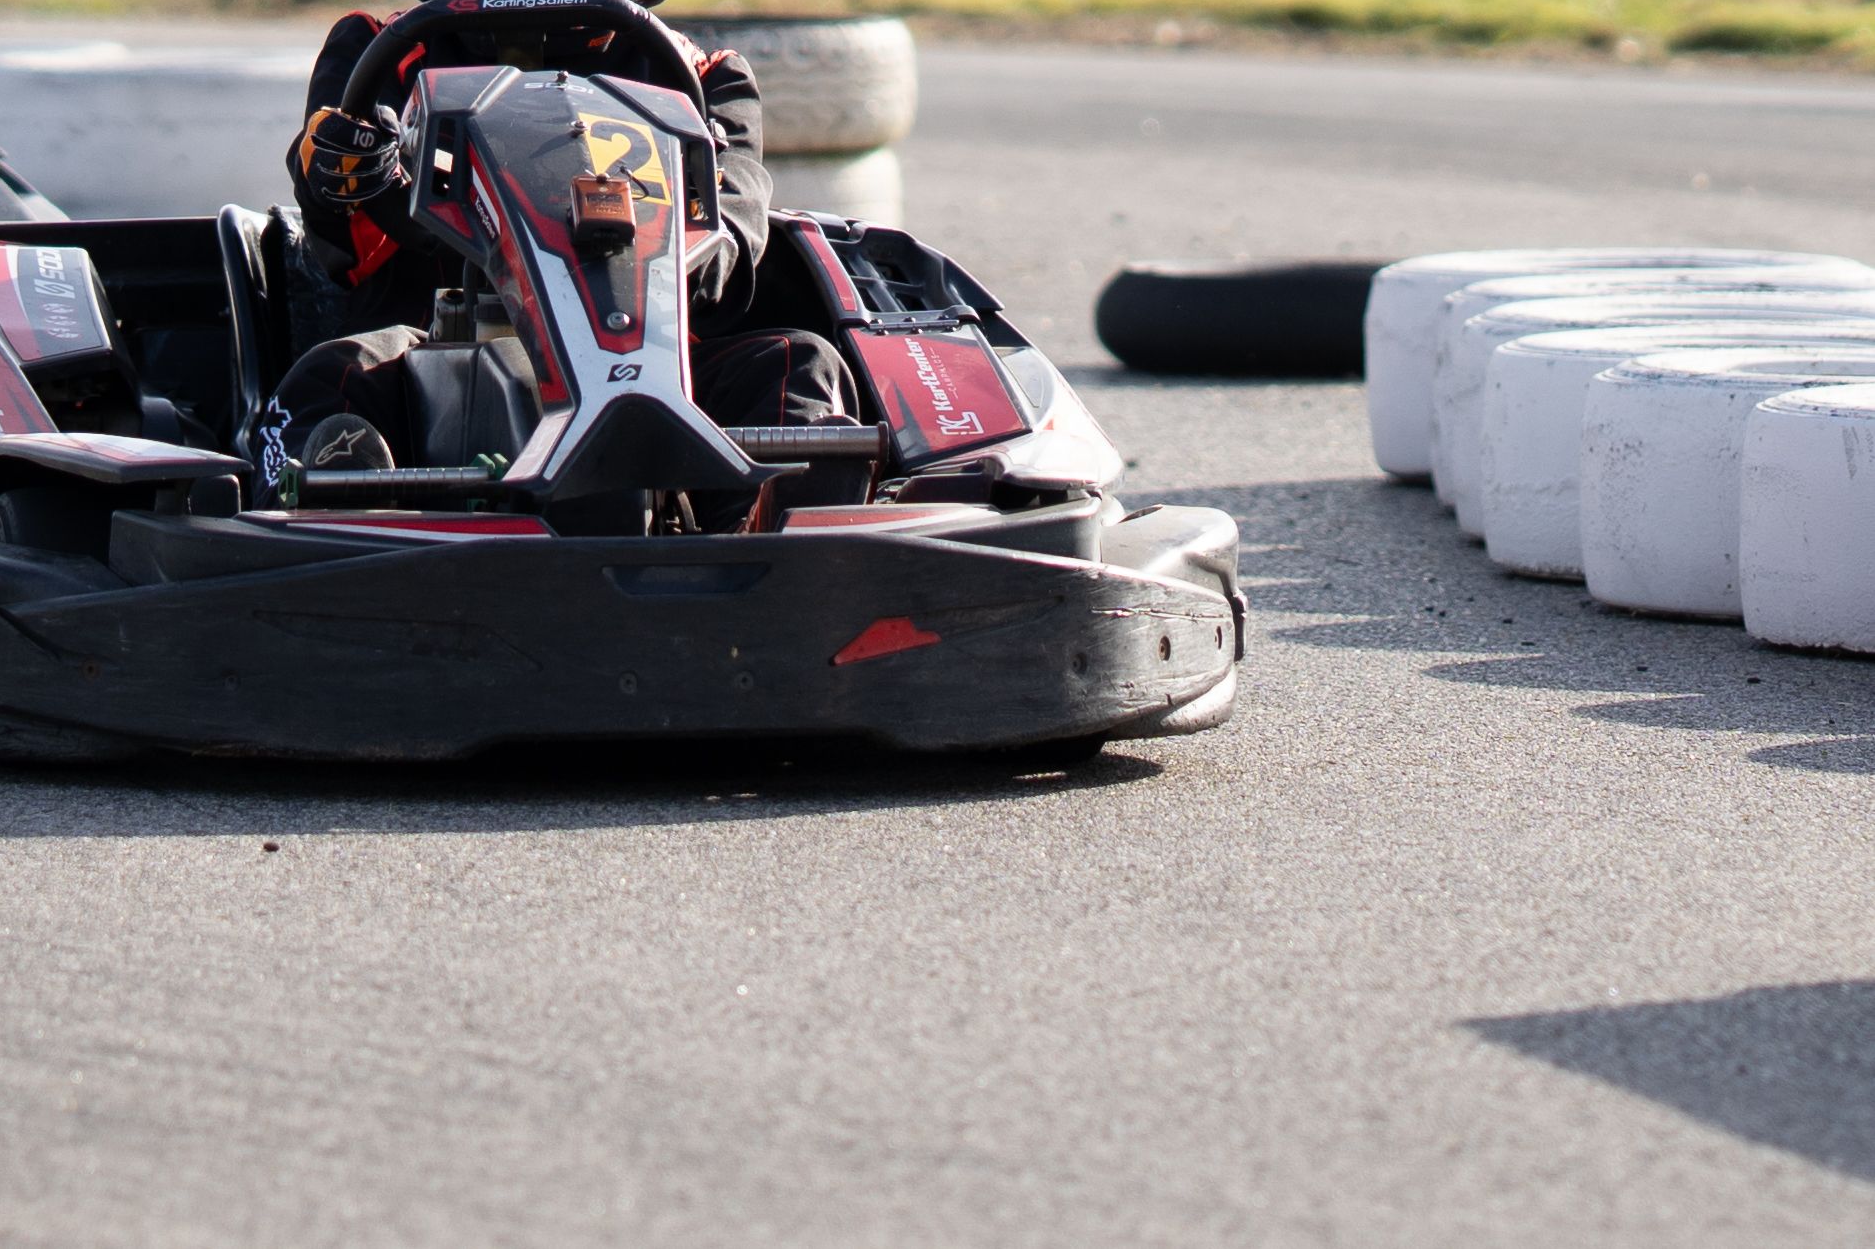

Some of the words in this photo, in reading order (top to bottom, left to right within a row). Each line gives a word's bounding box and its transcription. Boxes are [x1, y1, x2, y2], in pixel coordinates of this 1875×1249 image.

[590, 120, 666, 200] 2
[36, 249, 66, 281] SOD
[905, 338, 954, 411] KartCenter
